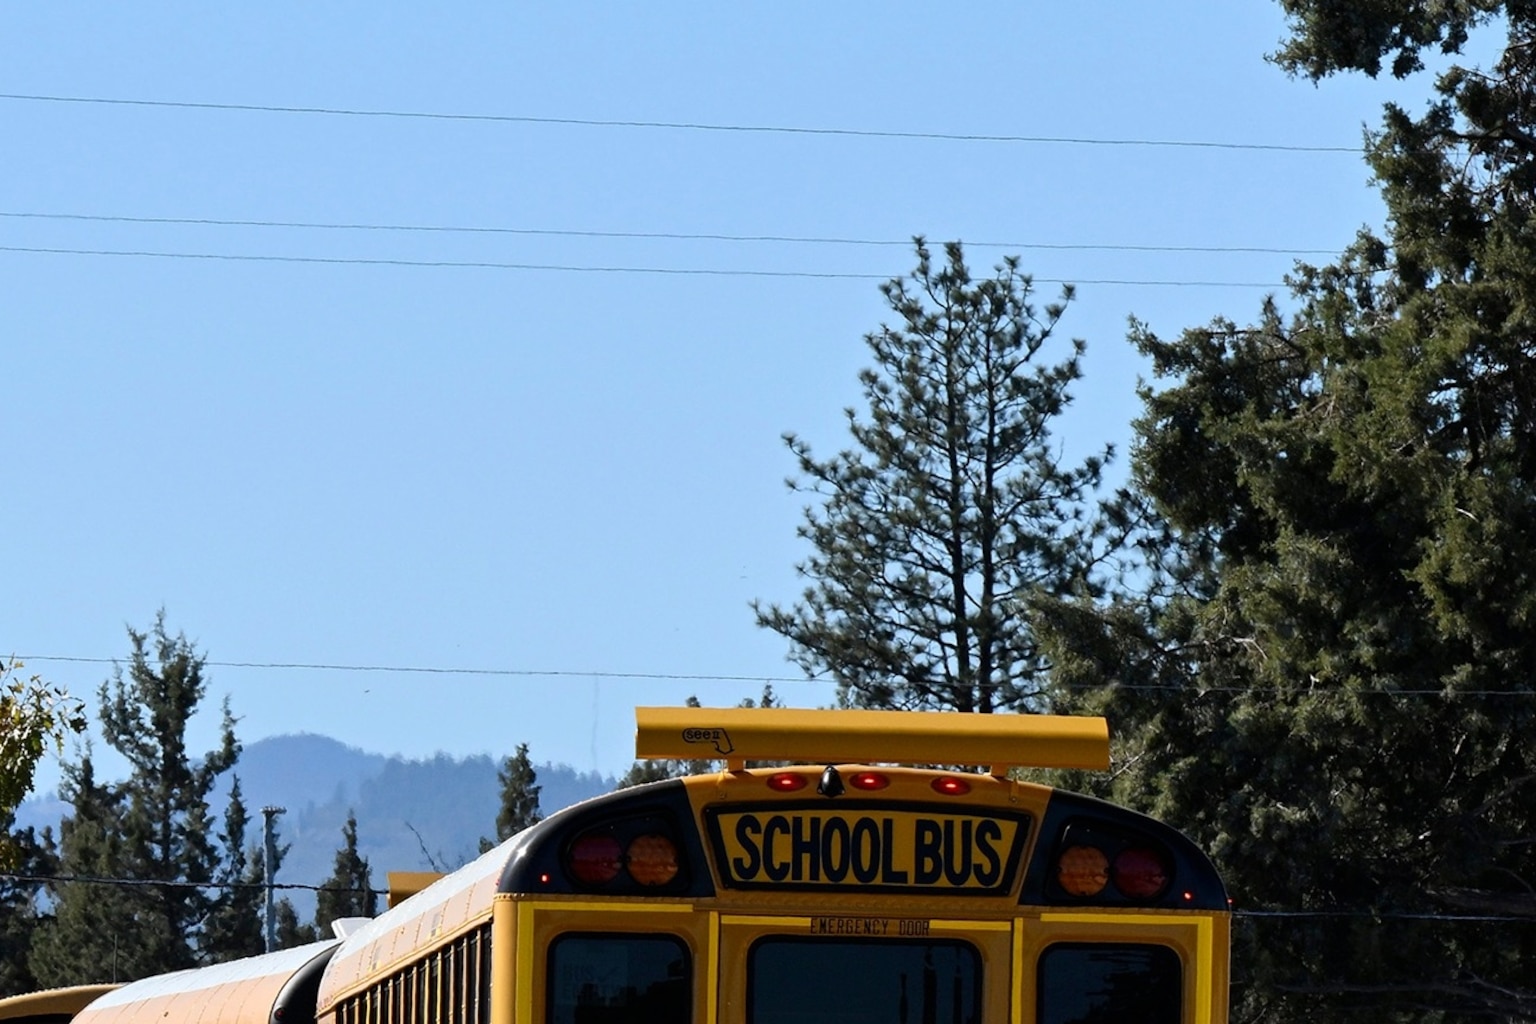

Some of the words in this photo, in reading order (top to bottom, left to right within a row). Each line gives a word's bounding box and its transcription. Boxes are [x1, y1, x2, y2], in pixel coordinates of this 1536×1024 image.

[733, 814, 908, 884] SCHOOL
[916, 818, 1002, 887] BUS
[810, 917, 889, 935] EMERGENCY
[899, 919, 930, 936] DOOR
